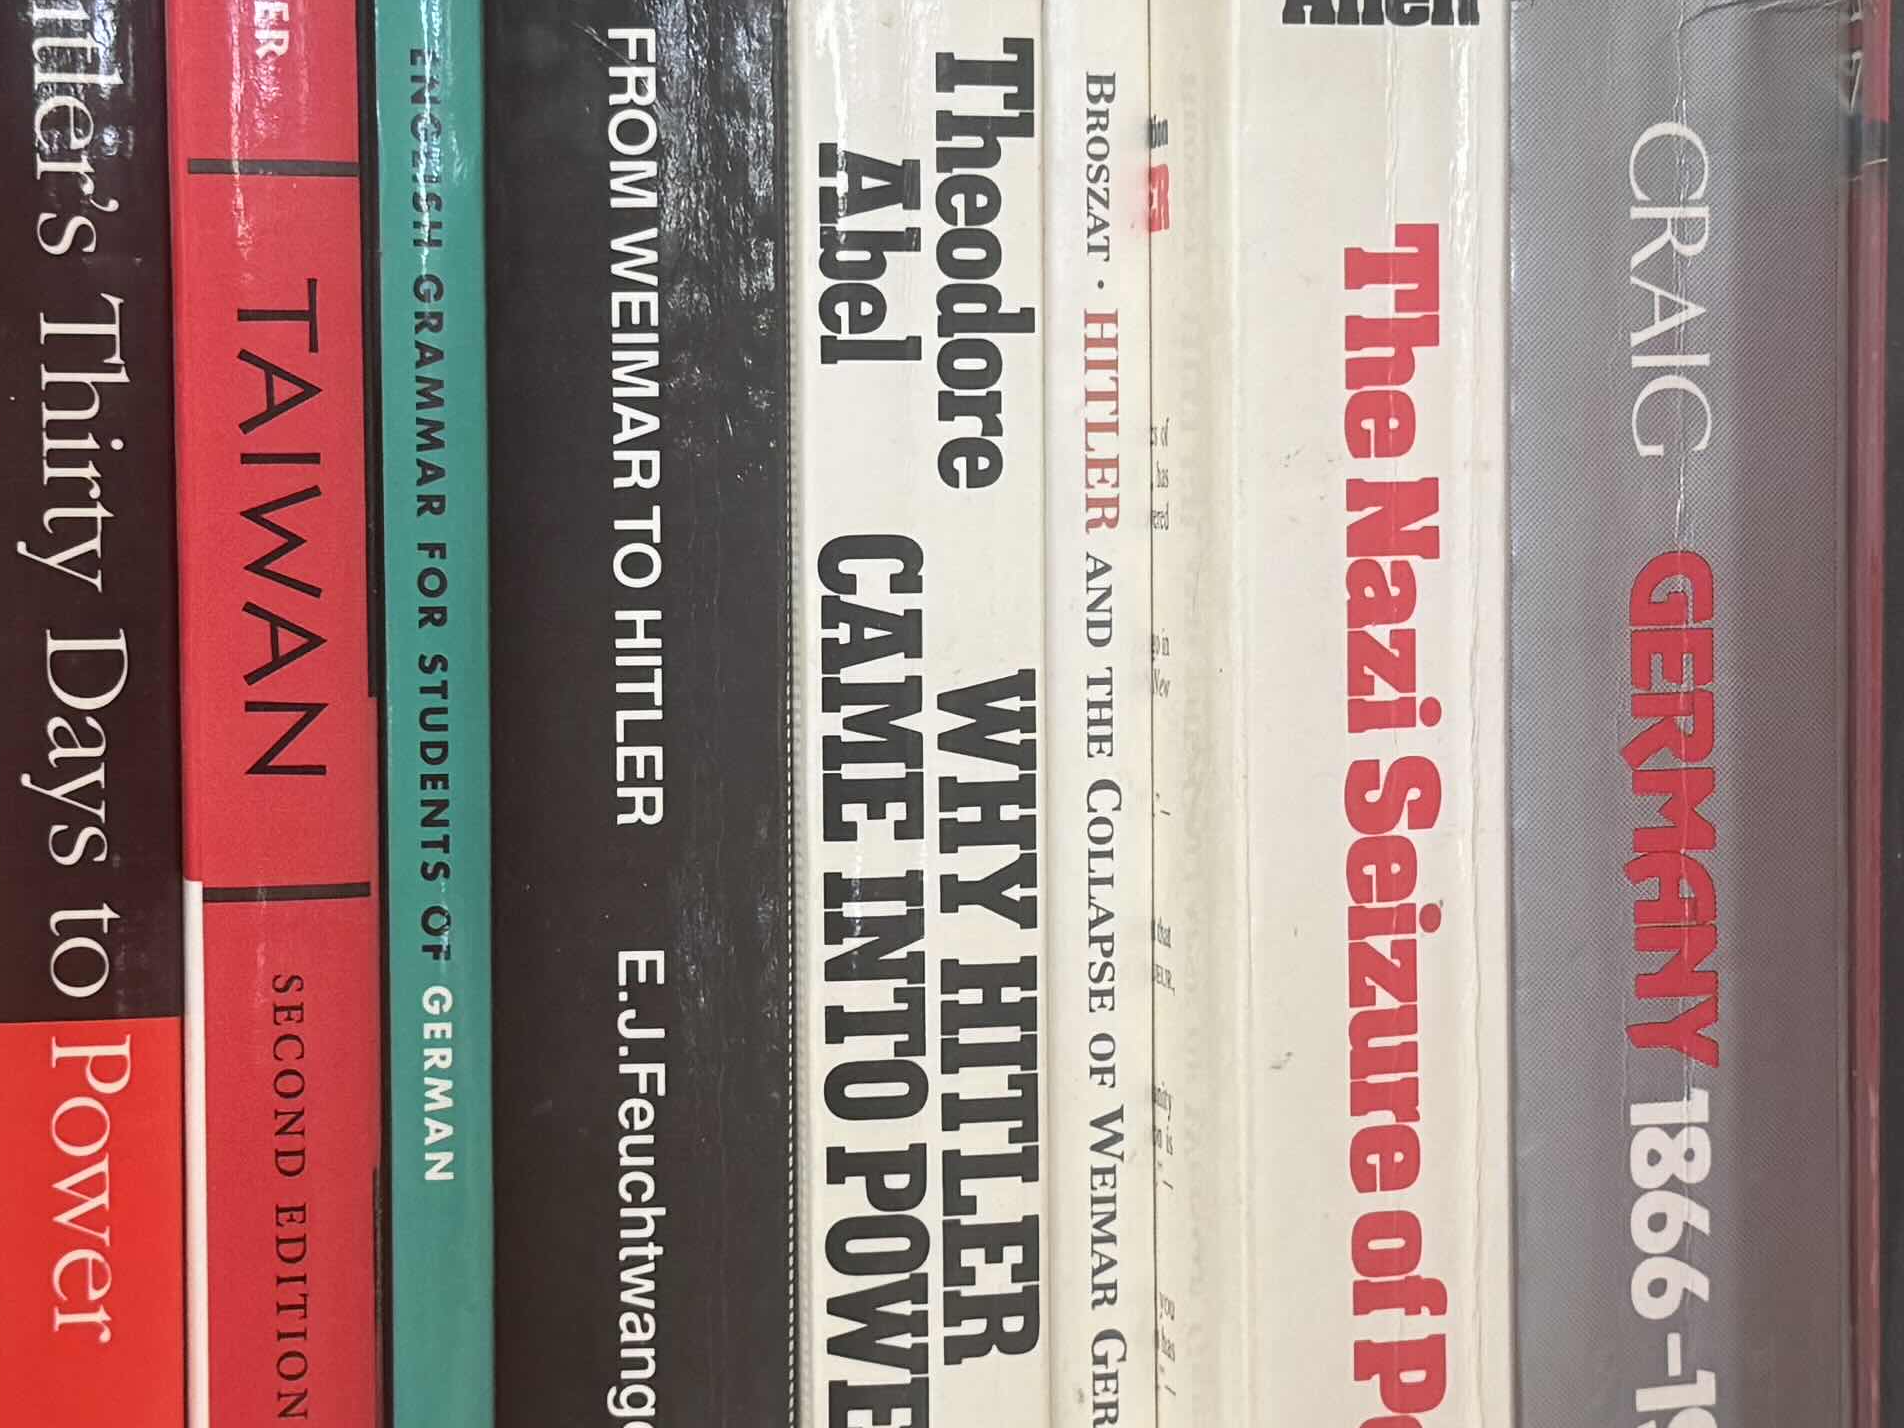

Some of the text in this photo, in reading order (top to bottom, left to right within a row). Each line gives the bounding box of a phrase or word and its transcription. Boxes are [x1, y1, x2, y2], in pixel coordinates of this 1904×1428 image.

[816, 141, 923, 366] Abel
[934, 36, 1037, 491] Theodore
[1081, 69, 1118, 263] BROSZAT
[412, 274, 447, 517] GRAMMAR
[1343, 222, 1441, 460] The
[1628, 120, 1713, 459] CRAIG
[16, 292, 127, 594] Thirty
[236, 277, 329, 778] TAIWAN
[607, 26, 665, 827] FROM WEIMAR TO HITLER
[1082, 306, 1121, 534] HITLER
[416, 540, 451, 629] FOR
[816, 533, 925, 843] CAME
[1084, 550, 1114, 649] AND
[1344, 476, 1443, 734] Nazi
[21, 627, 130, 867] Days
[418, 652, 452, 882] STUDENTS
[1085, 665, 1116, 760] THE
[1619, 548, 1721, 1070] GERMANY
[47, 906, 122, 999] to
[419, 905, 452, 962] OF
[822, 869, 930, 1123] INTO
[1085, 777, 1125, 1015] COLLAPSE
[1343, 754, 1444, 1195] Seizure
[421, 984, 455, 1183] GERMAN
[936, 667, 1040, 1366] WHY HITLER
[1087, 1033, 1118, 1090] OF
[49, 1034, 132, 1344] Power
[1088, 1103, 1126, 1312] WEIMAR
[1350, 1208, 1449, 1318] of
